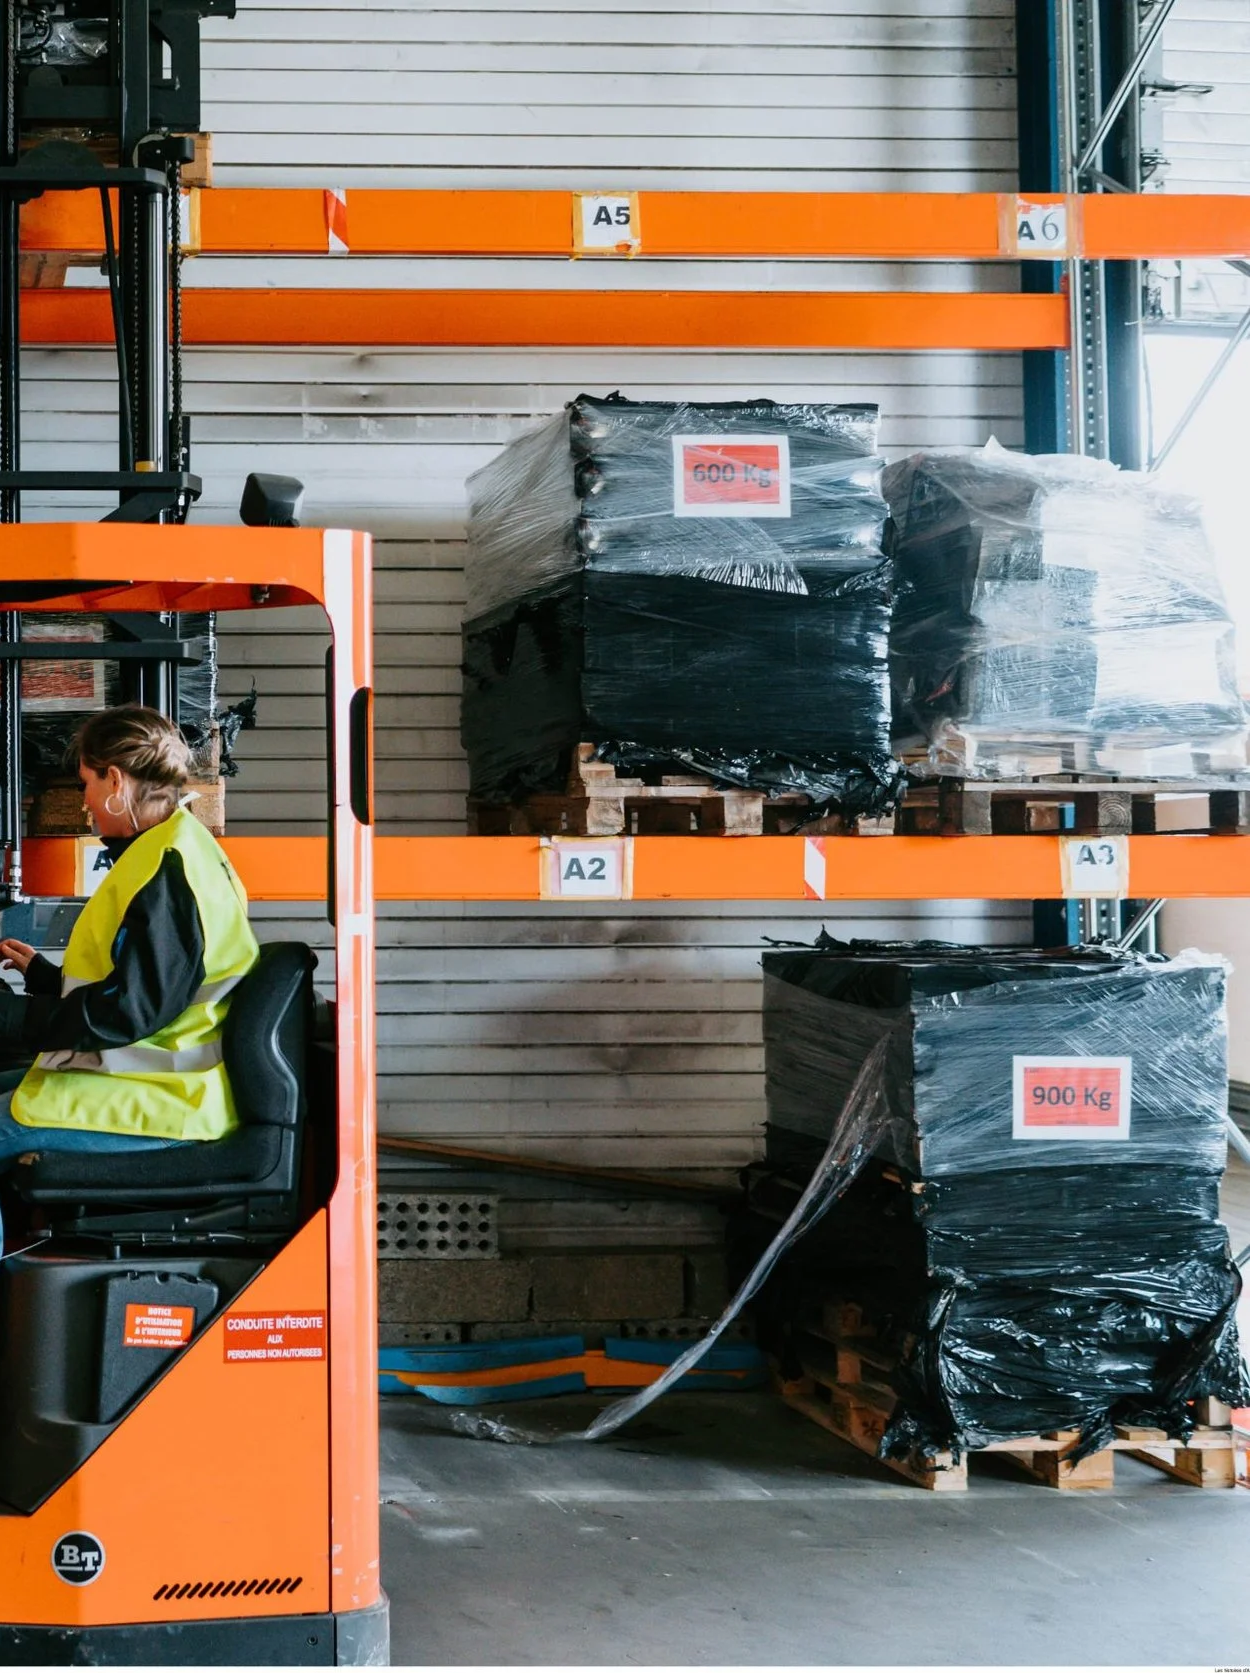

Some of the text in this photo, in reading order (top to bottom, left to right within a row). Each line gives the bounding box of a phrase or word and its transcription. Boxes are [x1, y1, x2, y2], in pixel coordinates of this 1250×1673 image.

[593, 206, 630, 225] A5
[693, 463, 735, 483] 600
[1076, 845, 1114, 865] A3
[563, 857, 606, 880] A2
[1032, 1086, 1112, 1112] 900 Kg
[227, 1316, 323, 1330] CONDUITE INTERDITE
[267, 1334, 283, 1344] AUX
[227, 1349, 266, 1360] PERSONNES
[268, 1348, 282, 1358] NON
[61, 1545, 99, 1571] BT
